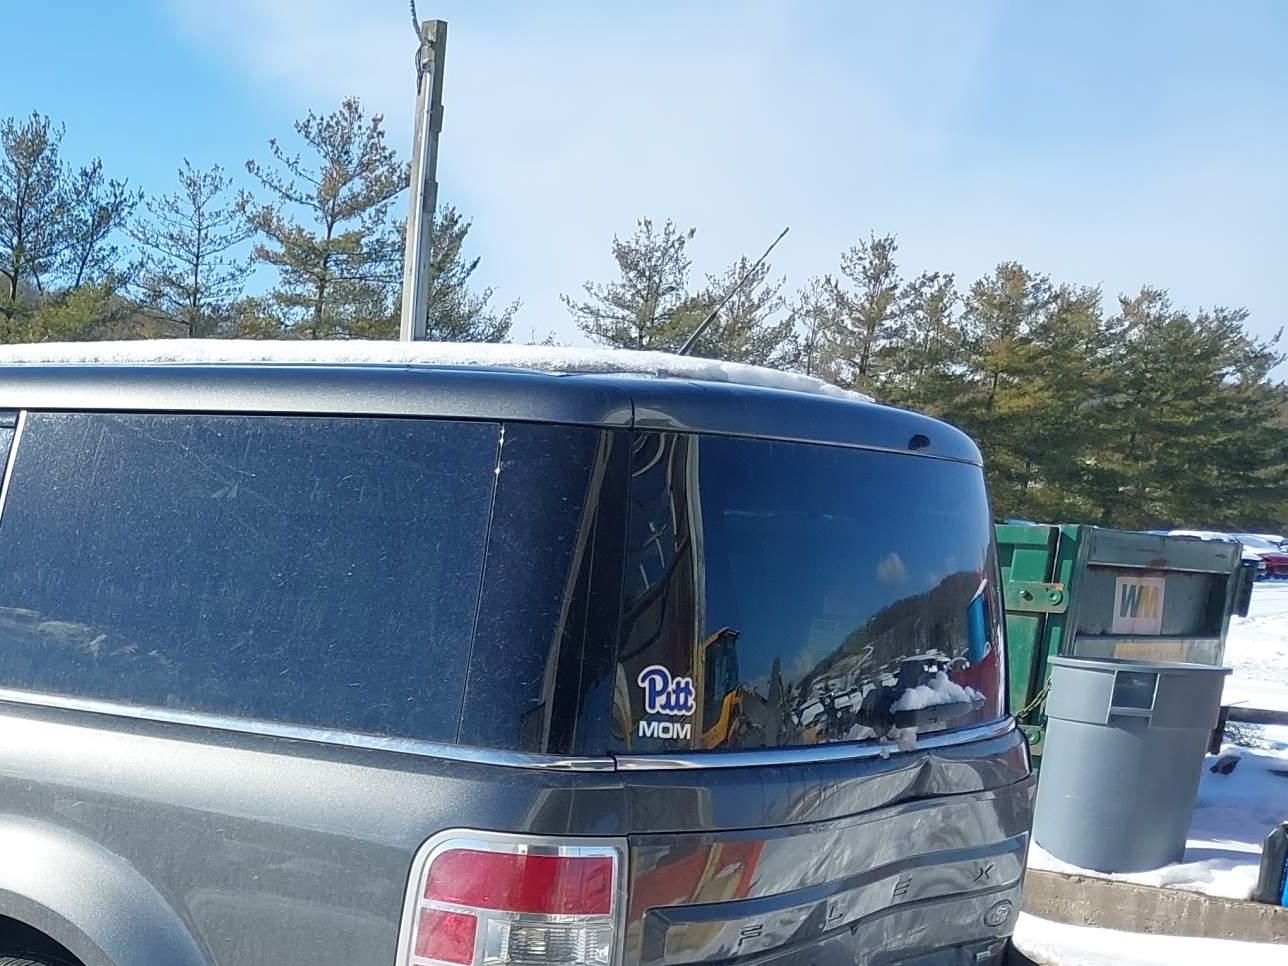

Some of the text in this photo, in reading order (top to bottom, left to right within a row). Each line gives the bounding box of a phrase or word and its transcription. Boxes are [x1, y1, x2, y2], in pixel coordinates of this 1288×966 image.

[1119, 583, 1160, 618] WM
[638, 665, 696, 716] Pitt
[638, 720, 692, 740] MOM
[737, 863, 995, 947] FLEX
